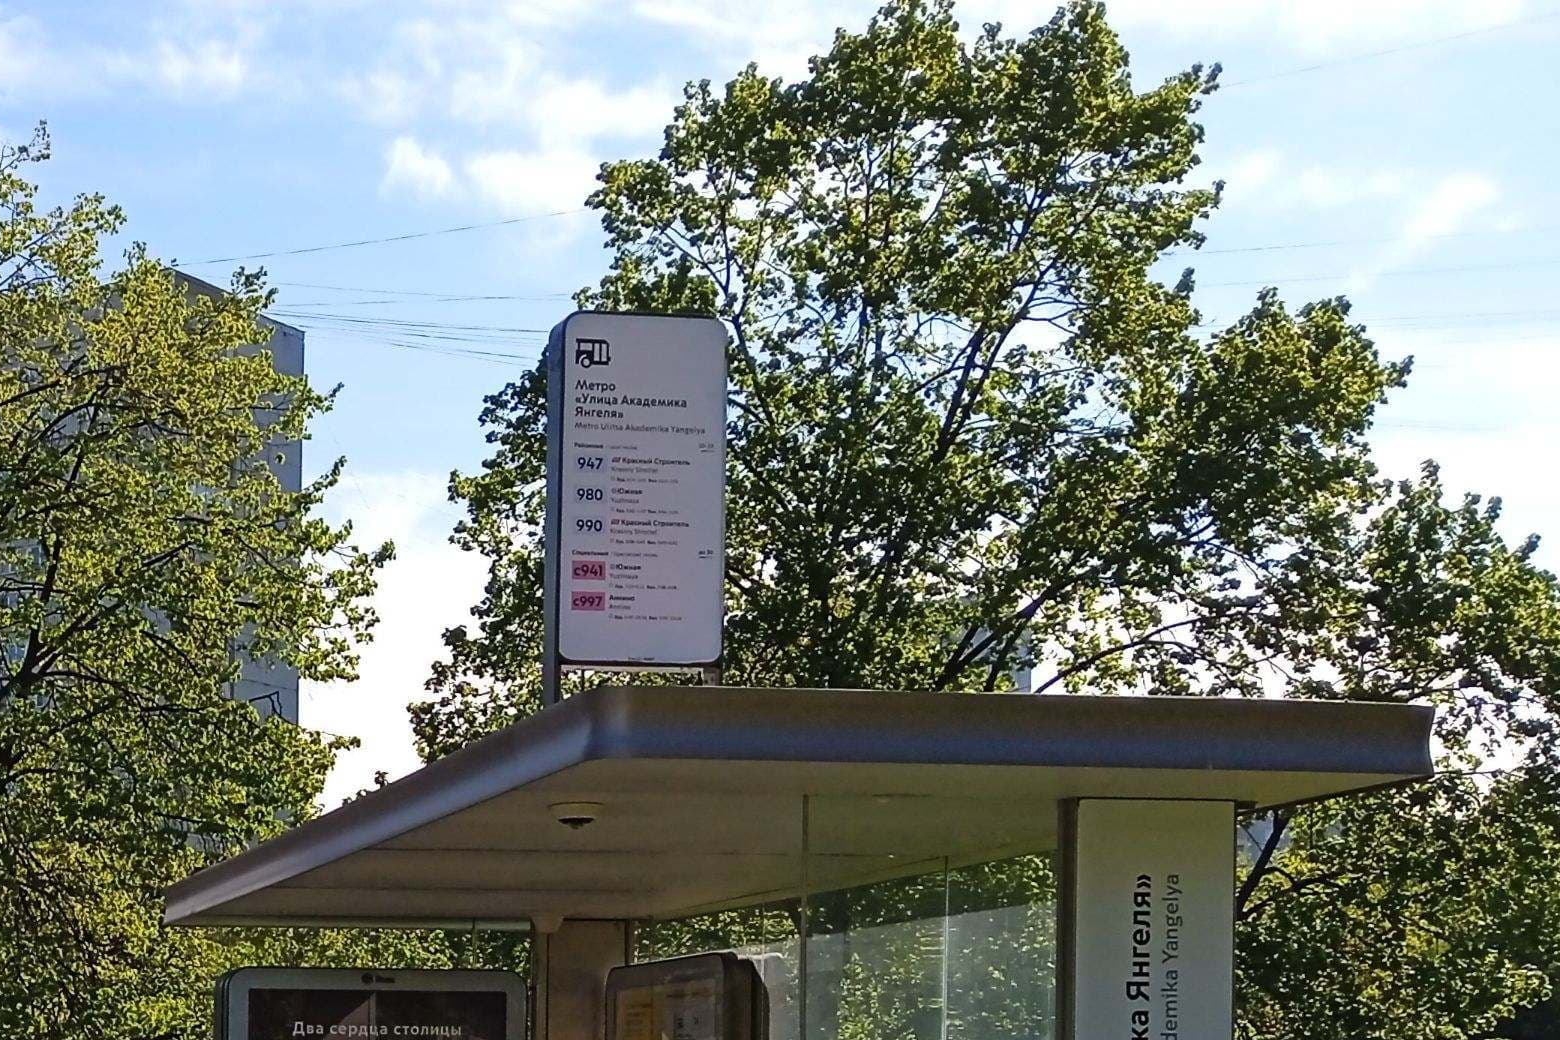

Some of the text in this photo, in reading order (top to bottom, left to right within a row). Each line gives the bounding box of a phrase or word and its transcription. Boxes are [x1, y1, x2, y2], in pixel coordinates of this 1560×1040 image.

[575, 379, 616, 392] Метро
[575, 393, 687, 409] «Улица Академика
[574, 407, 624, 419] Янгеля»
[574, 422, 598, 431] Metro
[577, 457, 603, 470] 947
[576, 488, 603, 501] 980
[576, 519, 603, 532] 990
[573, 564, 603, 577] с941
[572, 595, 603, 608] с997
[1161, 874, 1182, 964] Yangelya
[1126, 874, 1152, 1001] Янгеля»
[292, 1021, 462, 1038] Два сердца столицы
